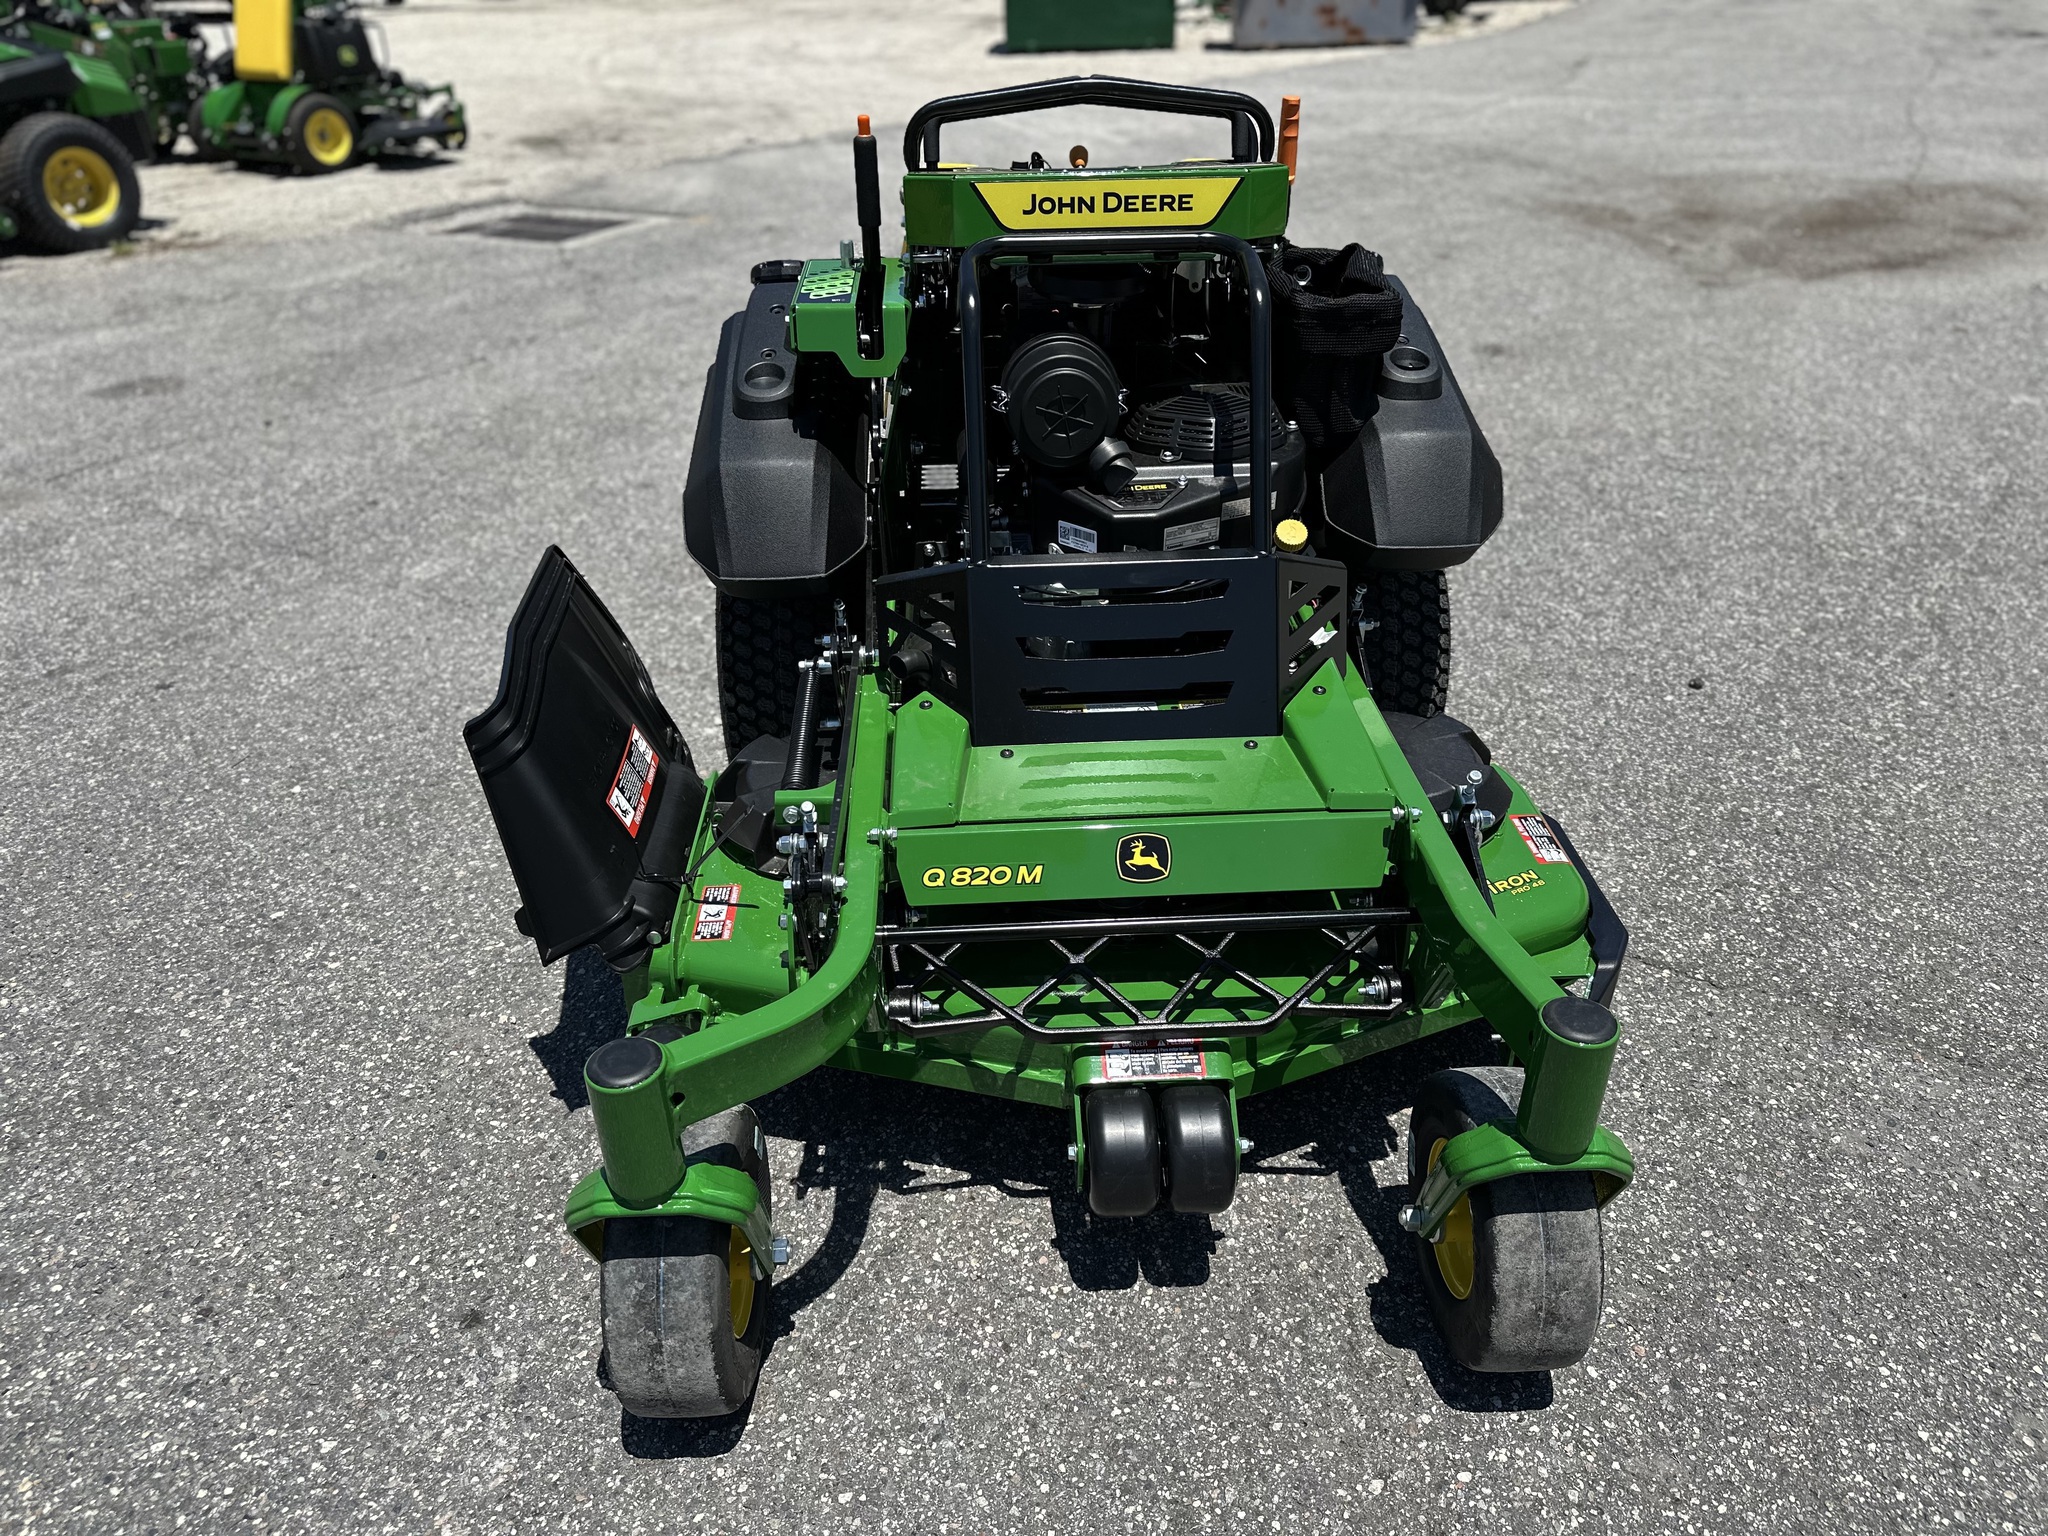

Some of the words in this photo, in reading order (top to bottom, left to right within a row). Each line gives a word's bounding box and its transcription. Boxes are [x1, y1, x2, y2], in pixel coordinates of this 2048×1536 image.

[1022, 194, 1095, 215] JOHN
[1103, 191, 1193, 213] DEERE
[1134, 483, 1167, 491] DEERE
[922, 867, 946, 888] Q
[951, 865, 1012, 887] 820
[1016, 864, 1044, 885] M
[1510, 885, 1531, 896] PRO
[1532, 879, 1546, 888] 48
